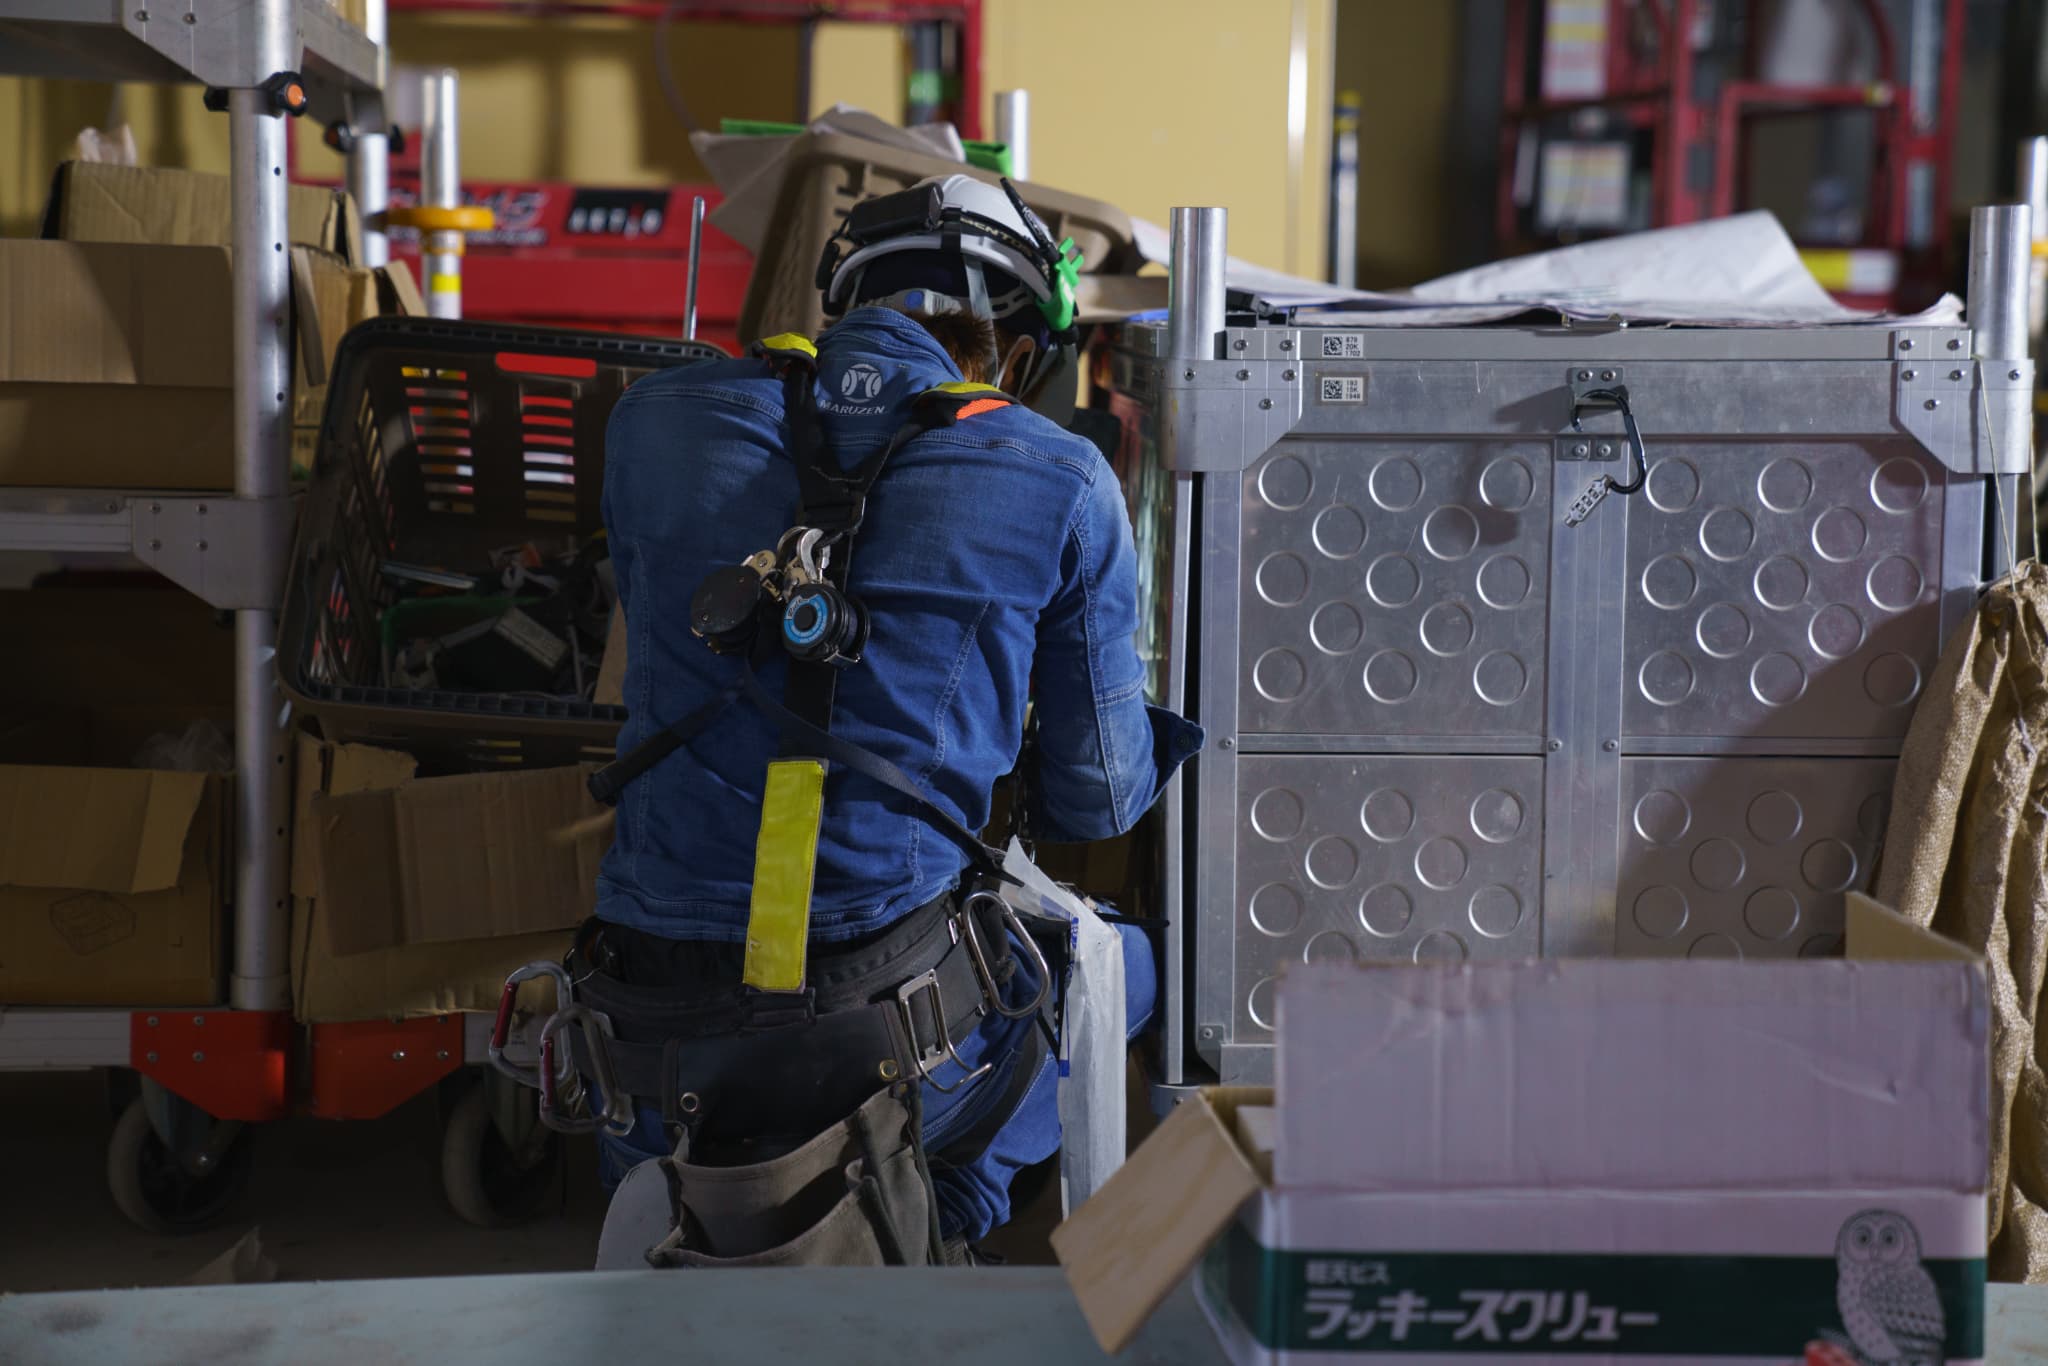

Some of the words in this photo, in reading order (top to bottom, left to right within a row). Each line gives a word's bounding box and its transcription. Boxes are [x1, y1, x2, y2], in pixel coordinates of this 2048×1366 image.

[820, 399, 885, 415] MARUZEN
[1304, 1289, 1660, 1342] ラッキースクリュー
